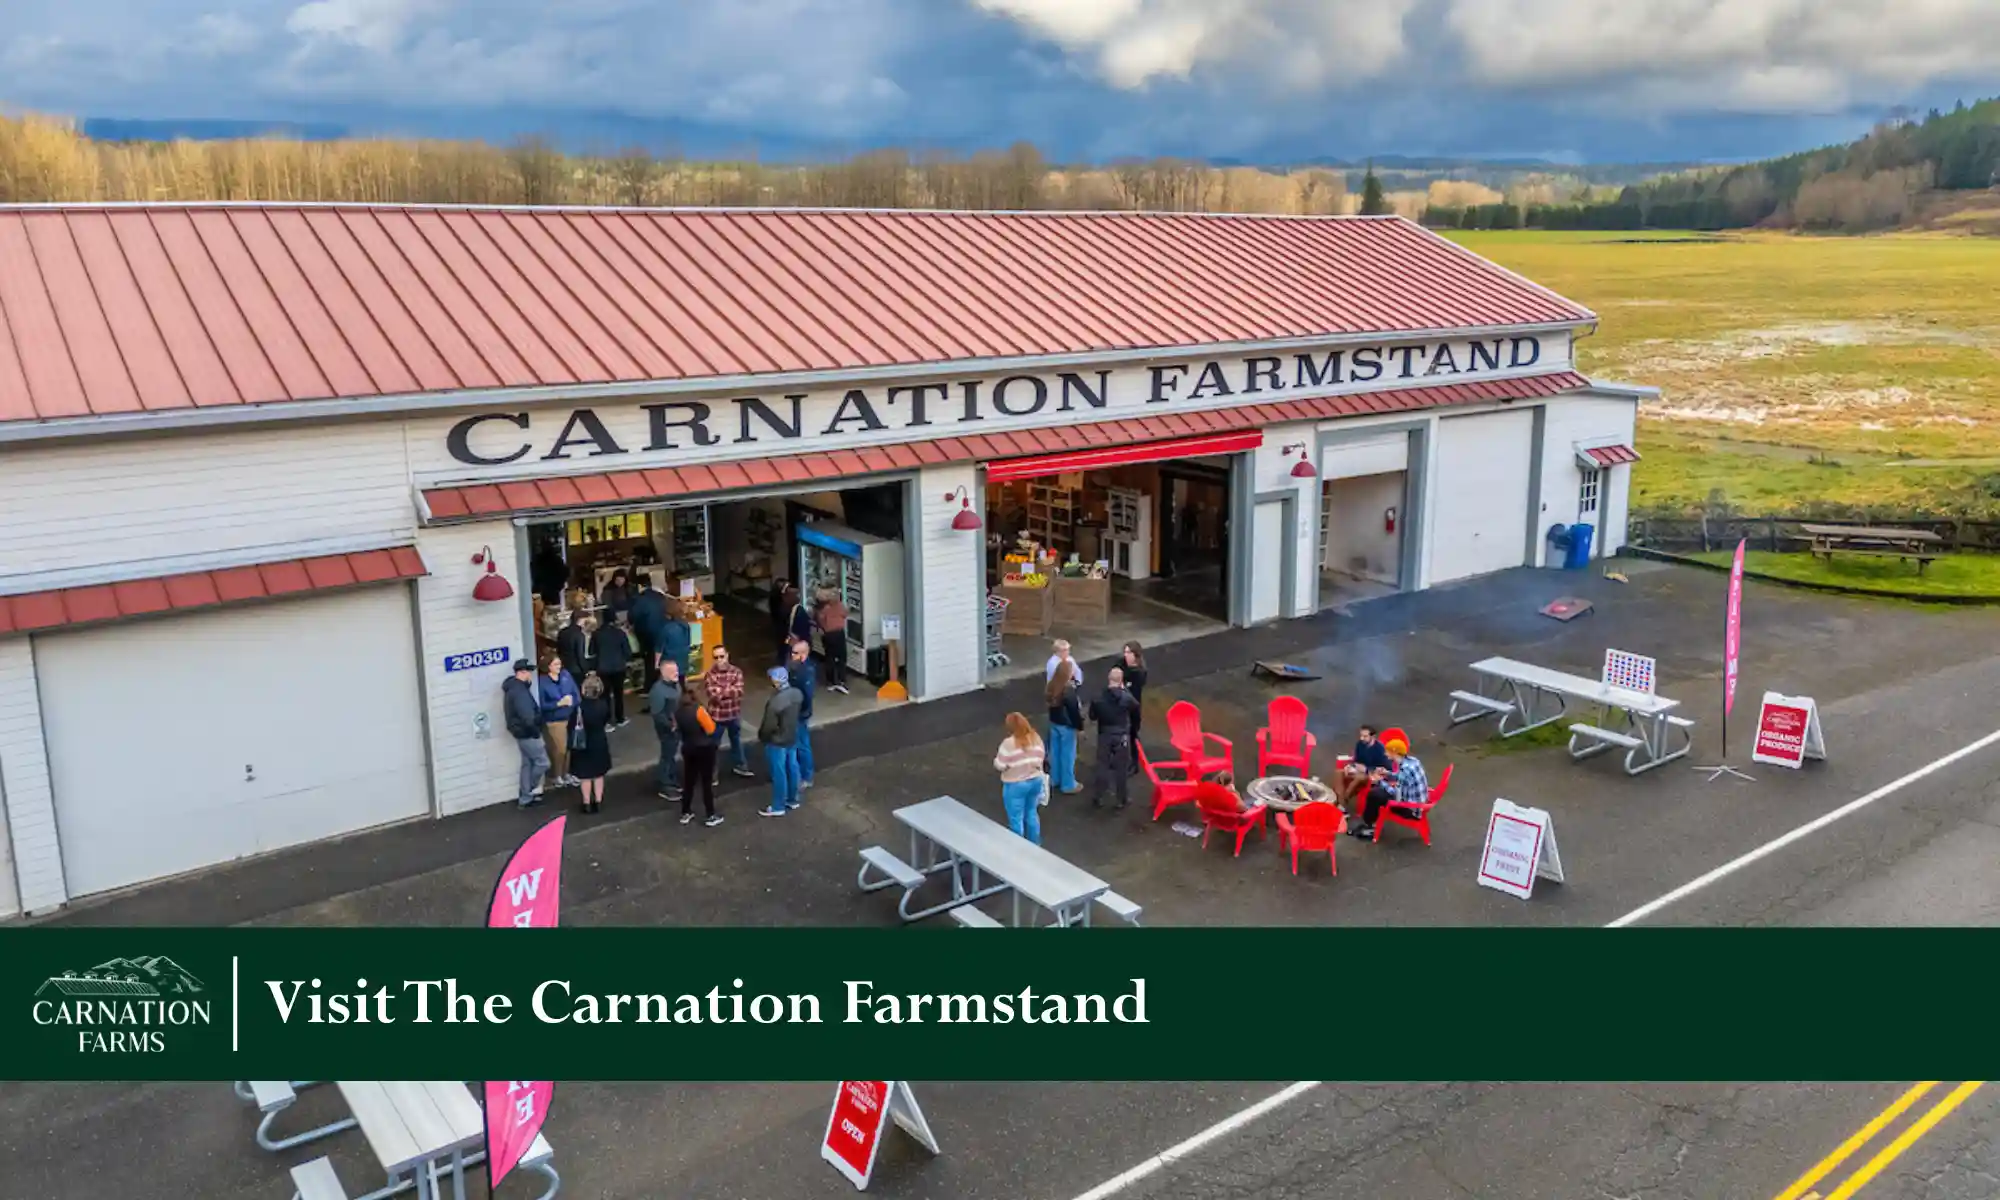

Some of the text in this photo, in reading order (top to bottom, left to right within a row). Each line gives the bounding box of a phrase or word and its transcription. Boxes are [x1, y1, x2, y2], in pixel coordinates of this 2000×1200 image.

[446, 334, 1541, 465] CARNATION FARMSTAND
[451, 649, 504, 671] 29030
[841, 1118, 866, 1144] OPEN
